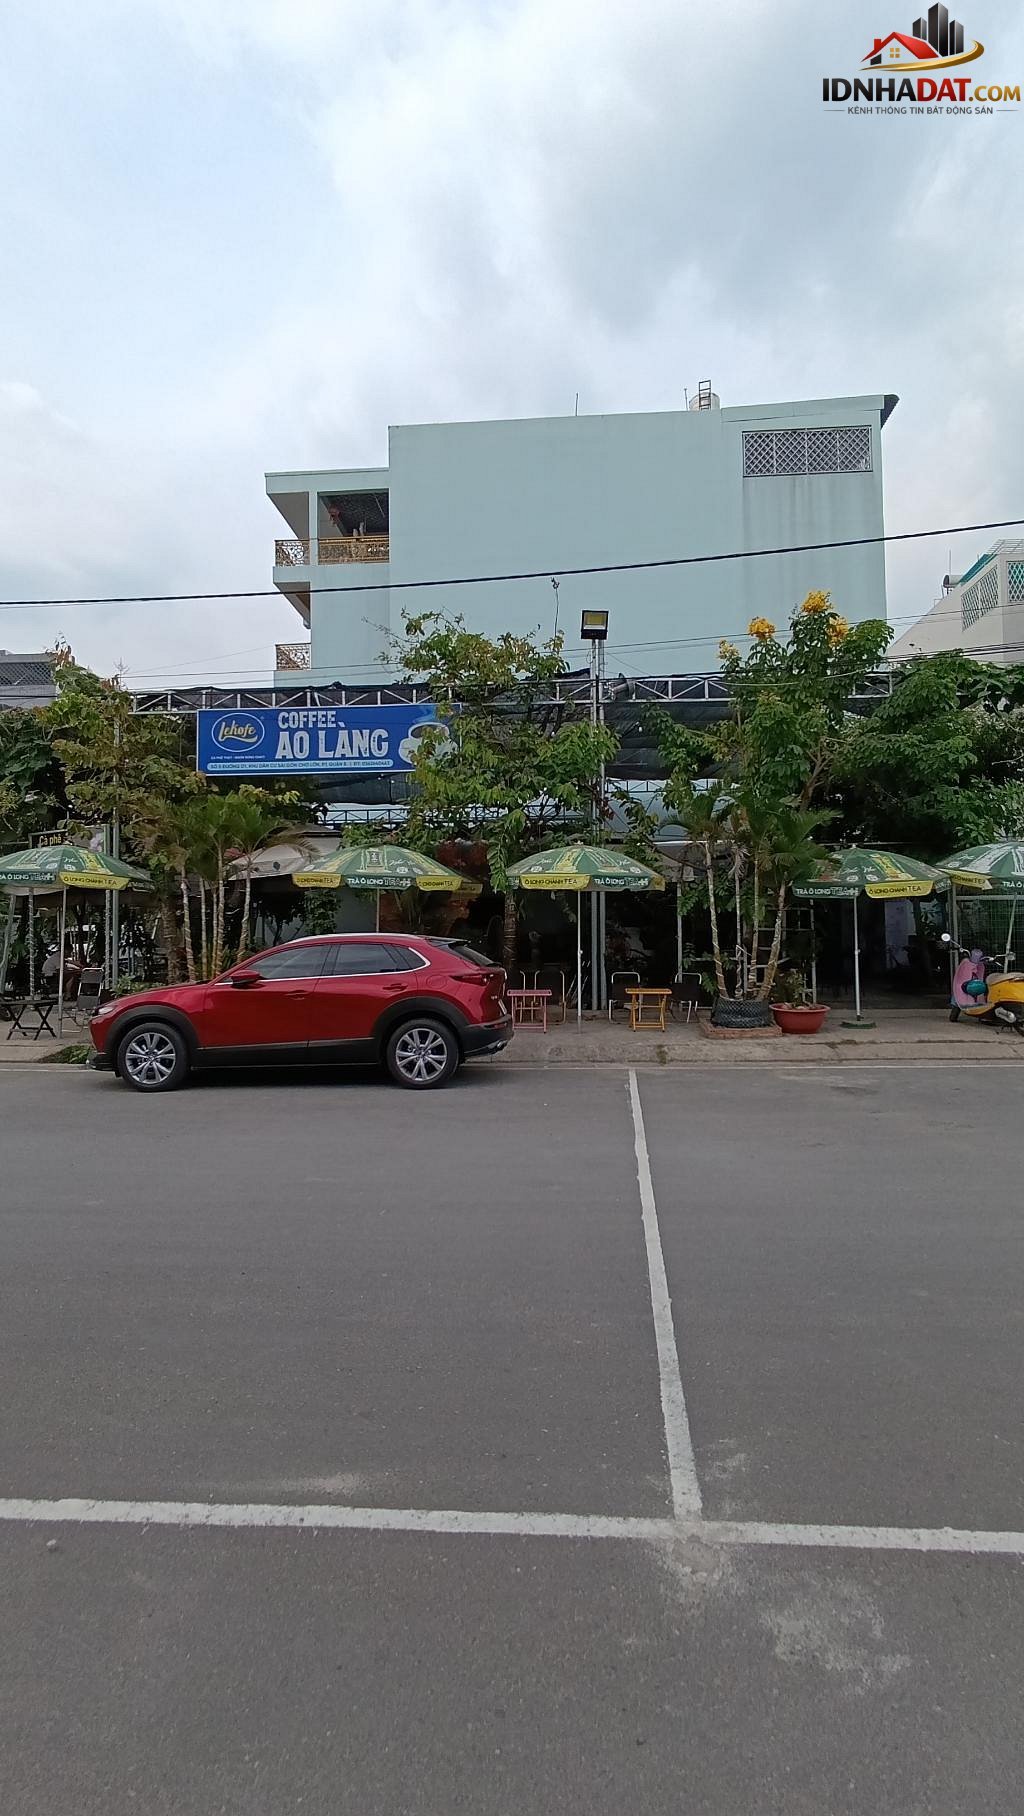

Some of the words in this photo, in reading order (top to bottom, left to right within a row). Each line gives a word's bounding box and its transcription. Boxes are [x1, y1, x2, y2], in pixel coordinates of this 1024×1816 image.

[278, 711, 337, 729] COFFEE
[275, 731, 310, 759] AO
[318, 721, 389, 759] LÀNG
